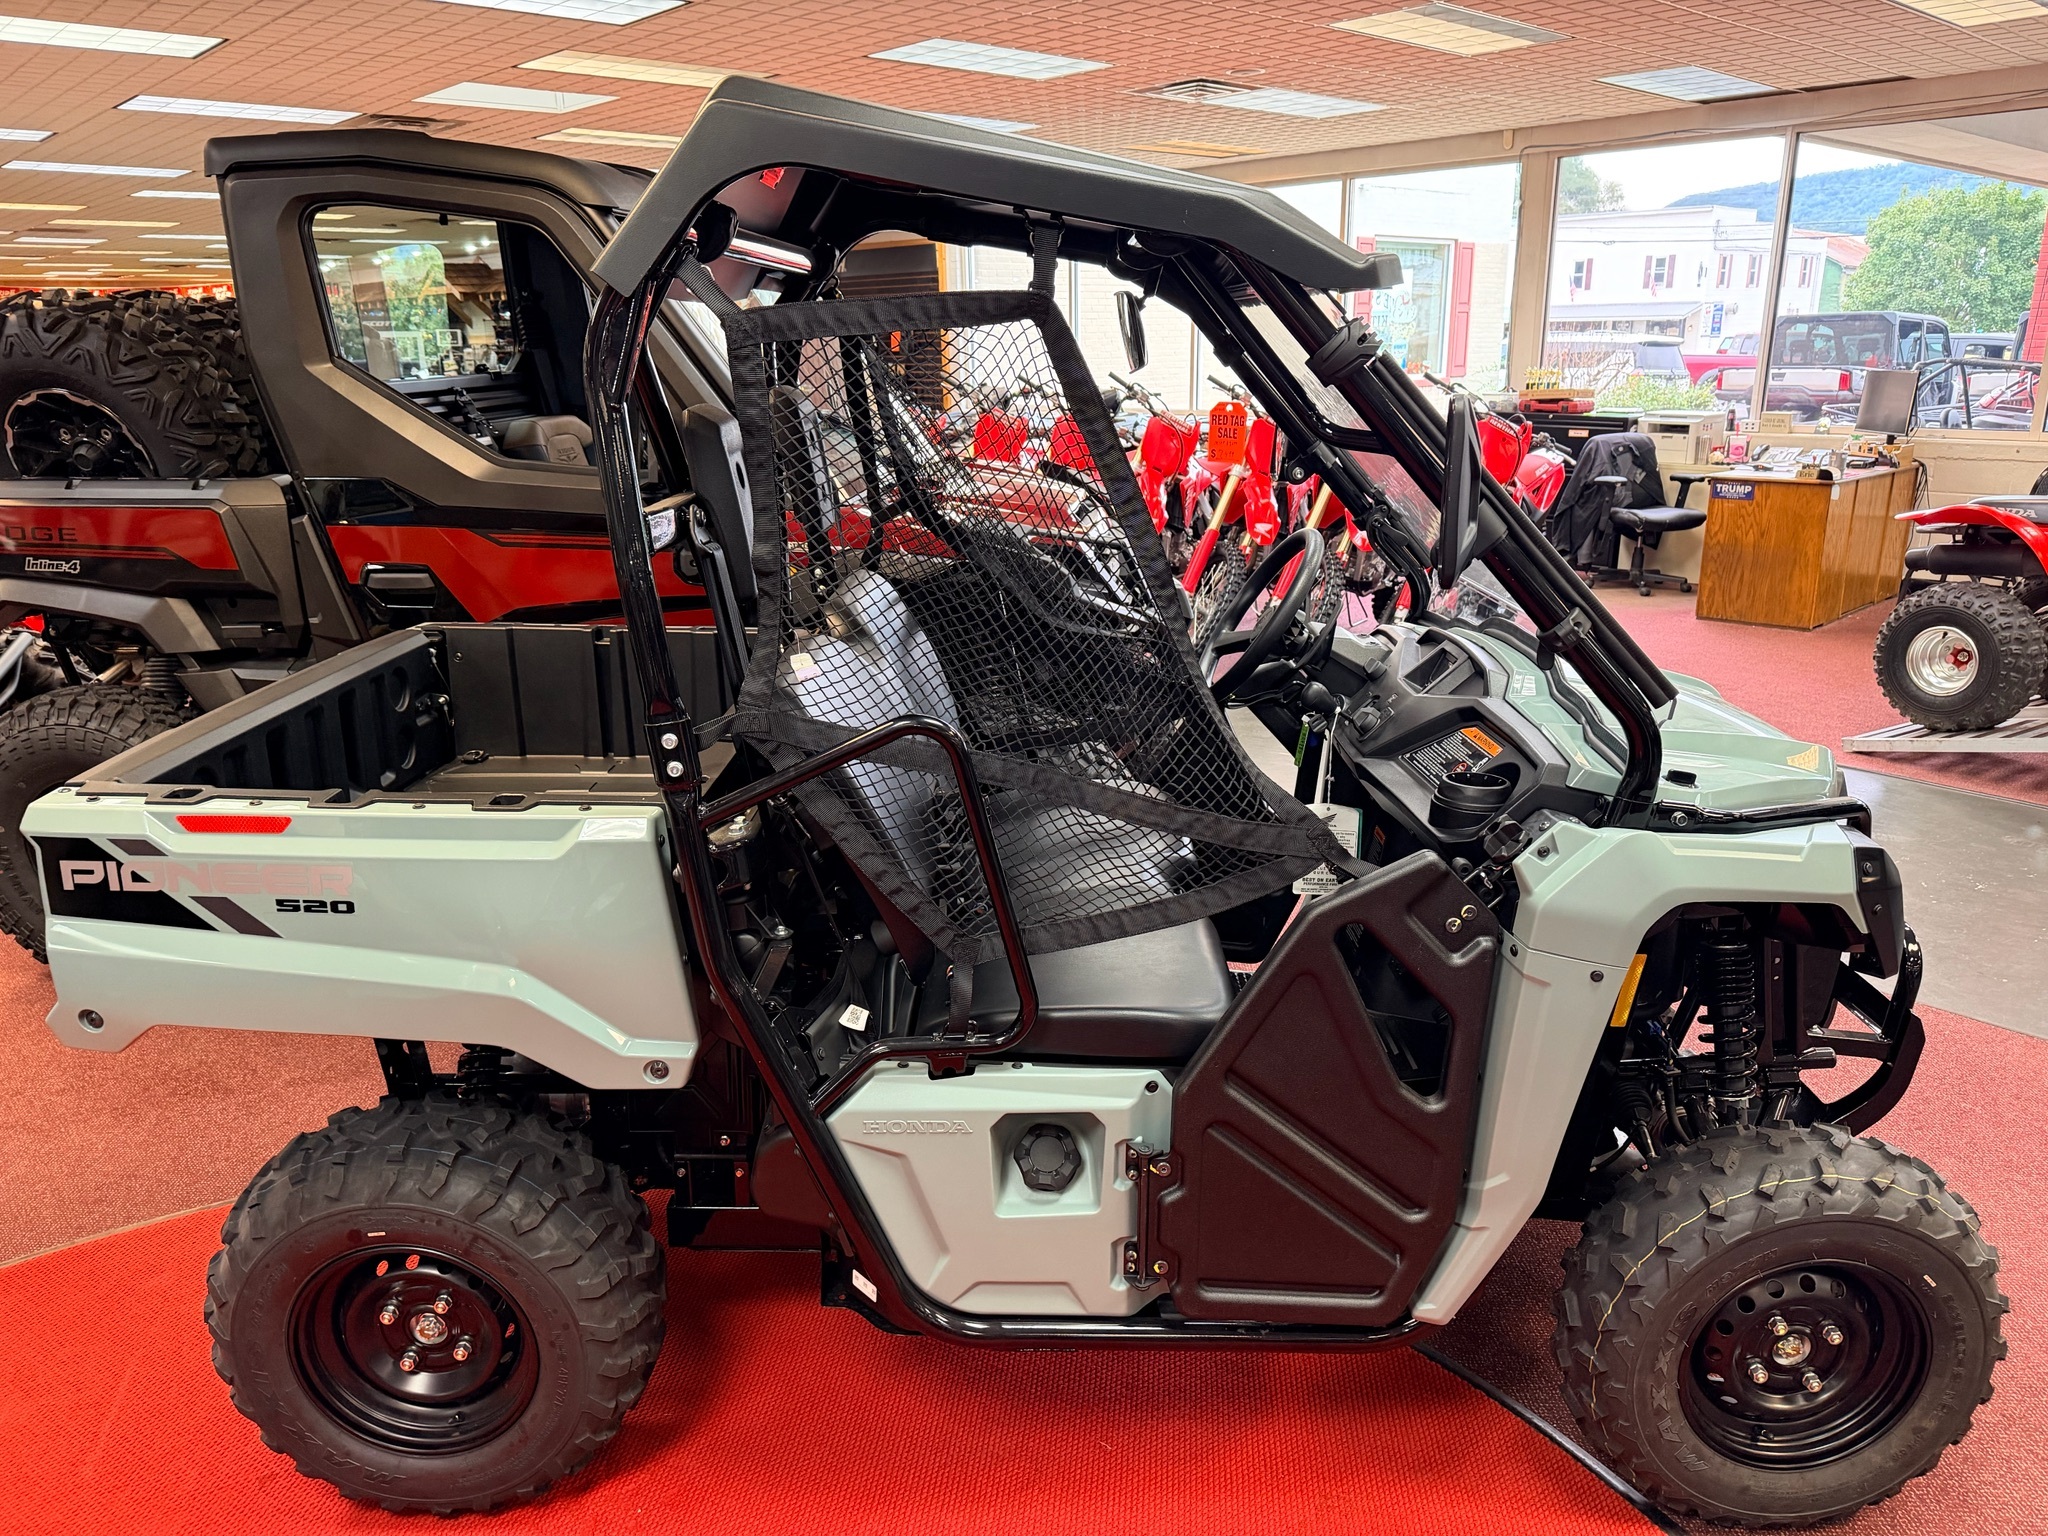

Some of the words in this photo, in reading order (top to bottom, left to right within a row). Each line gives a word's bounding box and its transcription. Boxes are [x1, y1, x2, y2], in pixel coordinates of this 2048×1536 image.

[1211, 414, 1229, 426] RED
[1230, 414, 1245, 427] TAG
[1217, 427, 1238, 439] SALE
[1800, 470, 1815, 478] Eric
[1715, 483, 1752, 494] TRUMP
[25, 557, 80, 573] Inline-4
[59, 860, 353, 896] PIONEER
[275, 899, 356, 915] 520
[863, 1120, 973, 1134] HONDA
[1650, 1300, 1710, 1472] MAXXIS
